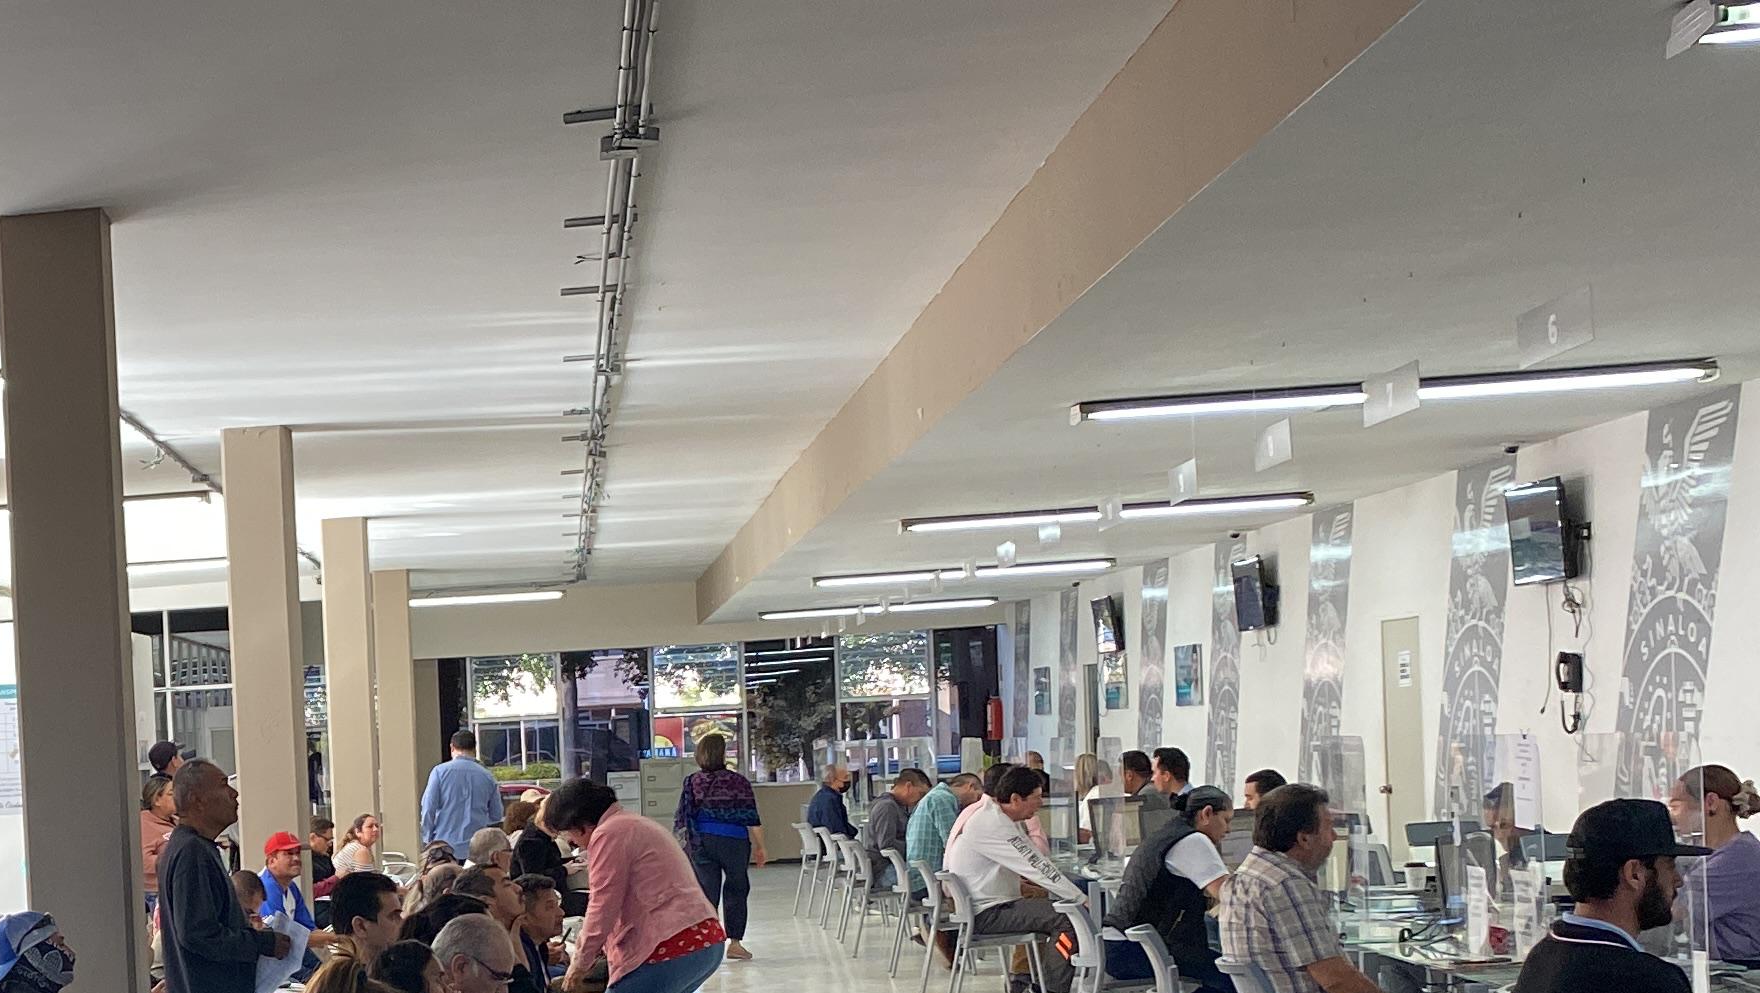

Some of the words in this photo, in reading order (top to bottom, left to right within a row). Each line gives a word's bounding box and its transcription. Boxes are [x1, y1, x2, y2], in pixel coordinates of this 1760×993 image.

[1547, 313, 1558, 345] 6
[1640, 613, 1708, 662] SINALOA
[1454, 638, 1500, 678] SINALOA
